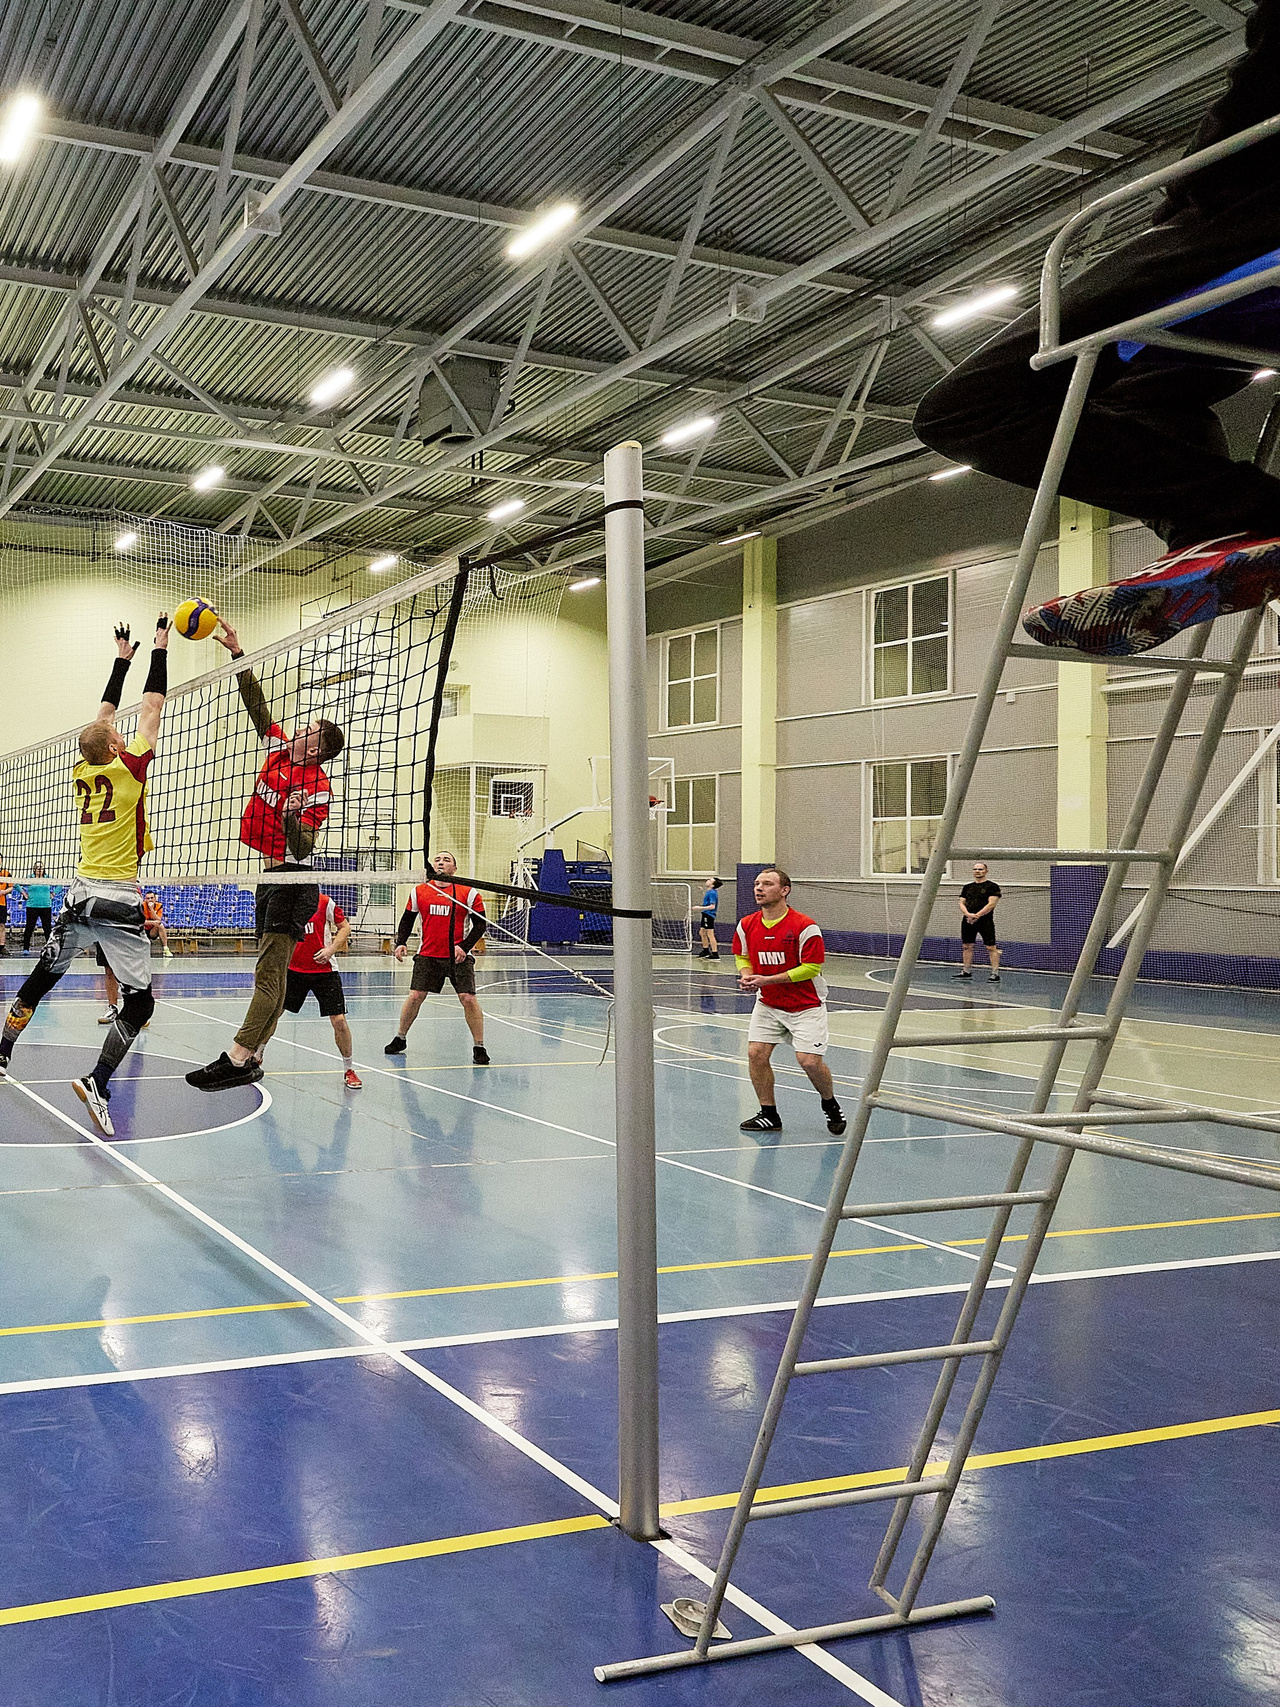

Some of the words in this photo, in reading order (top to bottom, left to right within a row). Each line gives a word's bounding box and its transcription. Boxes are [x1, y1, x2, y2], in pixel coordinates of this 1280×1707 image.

[76, 775, 116, 824] 22
[429, 904, 450, 916] ПМУ
[758, 951, 786, 965] ПМУ
